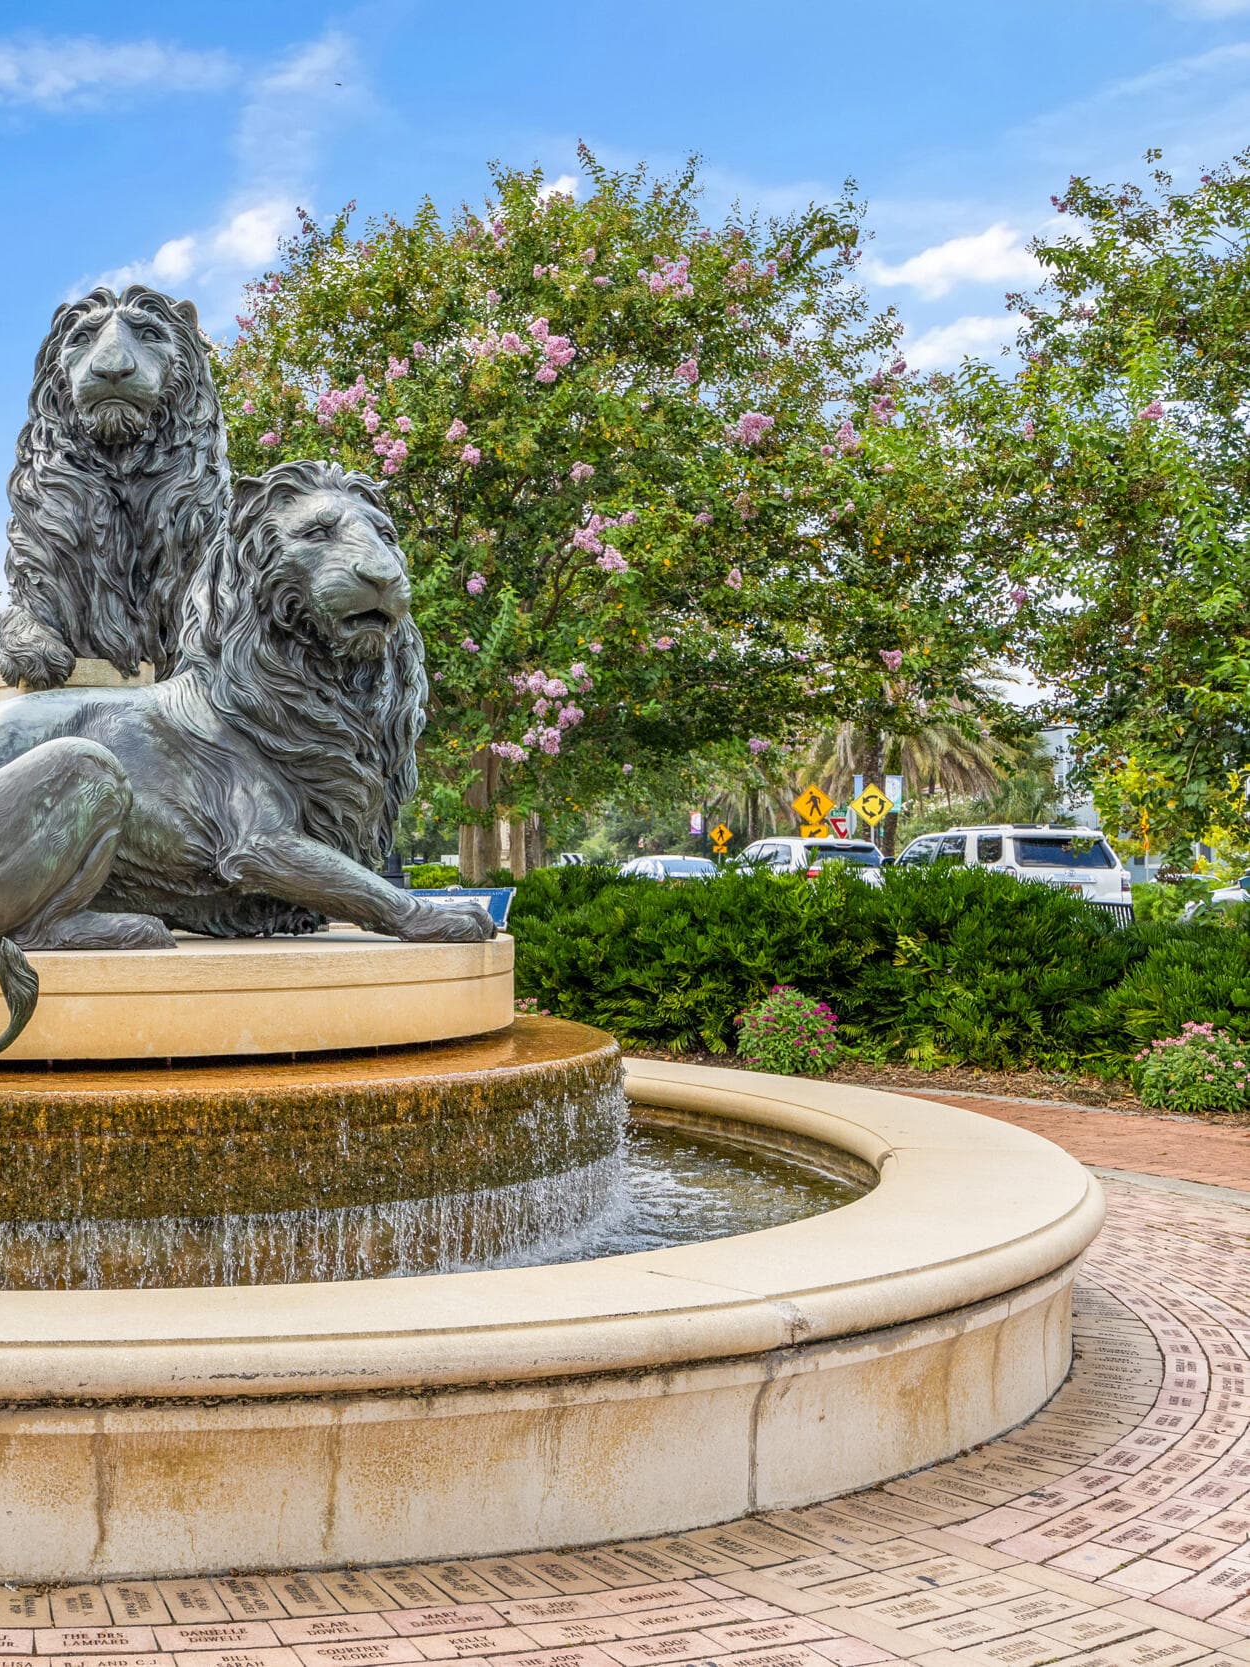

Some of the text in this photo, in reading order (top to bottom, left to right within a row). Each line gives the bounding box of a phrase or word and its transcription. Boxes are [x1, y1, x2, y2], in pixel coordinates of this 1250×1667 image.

[619, 1590, 683, 1604] CAROLINE
[421, 1611, 458, 1620] MARY
[532, 1606, 576, 1616] FAMILY
[411, 1615, 484, 1628] DANIELSEN
[640, 1615, 680, 1626] BECKY
[697, 1609, 728, 1618] BILL
[312, 1621, 348, 1629] ALAN
[180, 1628, 249, 1637] DANIELLE
[307, 1627, 360, 1636] DOWELL
[725, 1624, 779, 1637] REAGAN
[188, 1635, 244, 1643] DOWELL
[448, 1636, 489, 1645] KELLY
[750, 1631, 788, 1641] RILEY
[317, 1644, 390, 1655] COURTNEY
[455, 1641, 498, 1651] BARRY
[624, 1639, 691, 1652] THE JOOS
[332, 1651, 389, 1661] GEORGE
[645, 1646, 688, 1657] FAMILY
[518, 1654, 584, 1667] THE JOOS
[732, 1653, 799, 1667] MESQUITA
